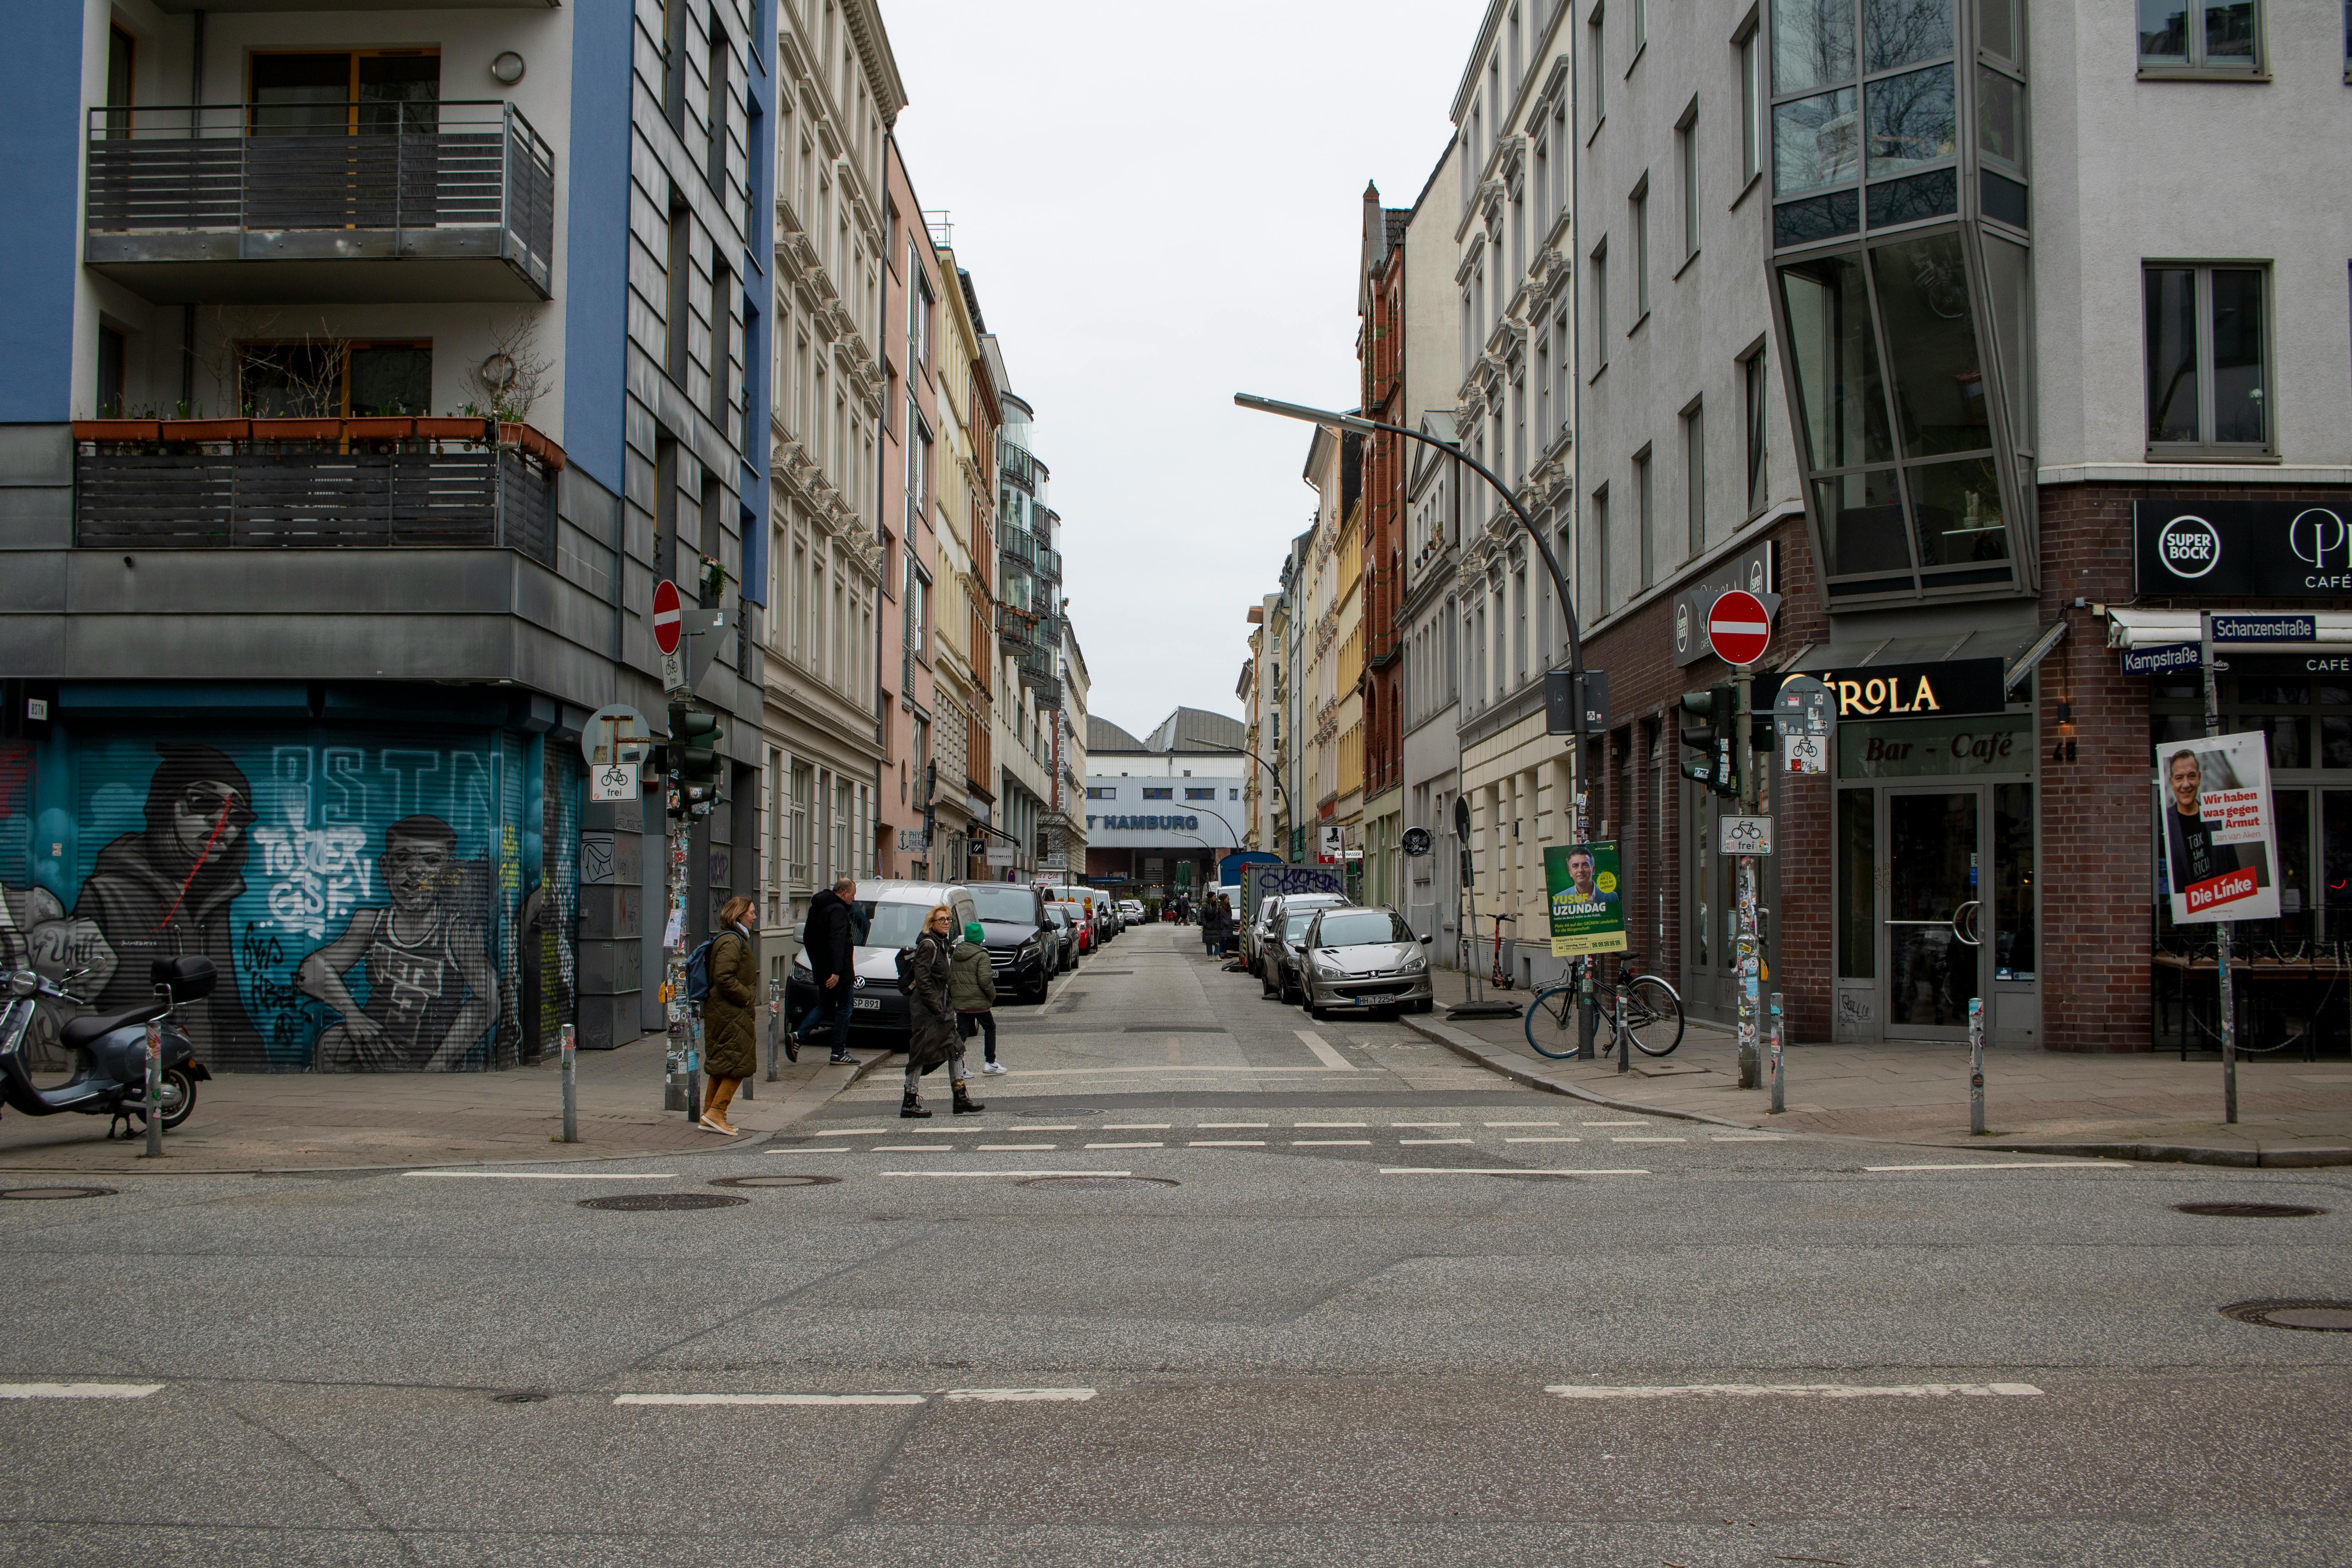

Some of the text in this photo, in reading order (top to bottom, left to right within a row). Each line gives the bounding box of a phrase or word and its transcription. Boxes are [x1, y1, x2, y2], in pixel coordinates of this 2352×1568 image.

[2167, 534, 2211, 547] SUPER
[2170, 546, 2210, 560] BOCK
[1751, 575, 1761, 589] SUPER
[2305, 574, 2352, 588] CAFÉ
[2217, 620, 2311, 637] Schanzenstraße
[2125, 646, 2198, 672] Kampstraße
[2307, 657, 2350, 671] CAFÉ
[1781, 673, 1940, 715] ROLA
[32, 703, 44, 716] BSTN
[1865, 738, 1913, 761] Bar
[1951, 732, 2013, 763] Café
[607, 788, 622, 796] frei
[2203, 792, 2257, 805] Wir haben
[2203, 805, 2258, 818] was gegen
[1086, 815, 1198, 829] T HAMBURG
[2225, 817, 2260, 829] Armut
[2214, 833, 2227, 842] Jan
[2243, 831, 2260, 840] Aken
[1738, 841, 1754, 850] frei
[2193, 848, 2204, 860] the
[1552, 893, 1589, 905] YUSUF
[2190, 878, 2252, 907] Die Linke
[1553, 902, 1606, 916] UZUNDAG
[864, 1000, 879, 1008] 891
